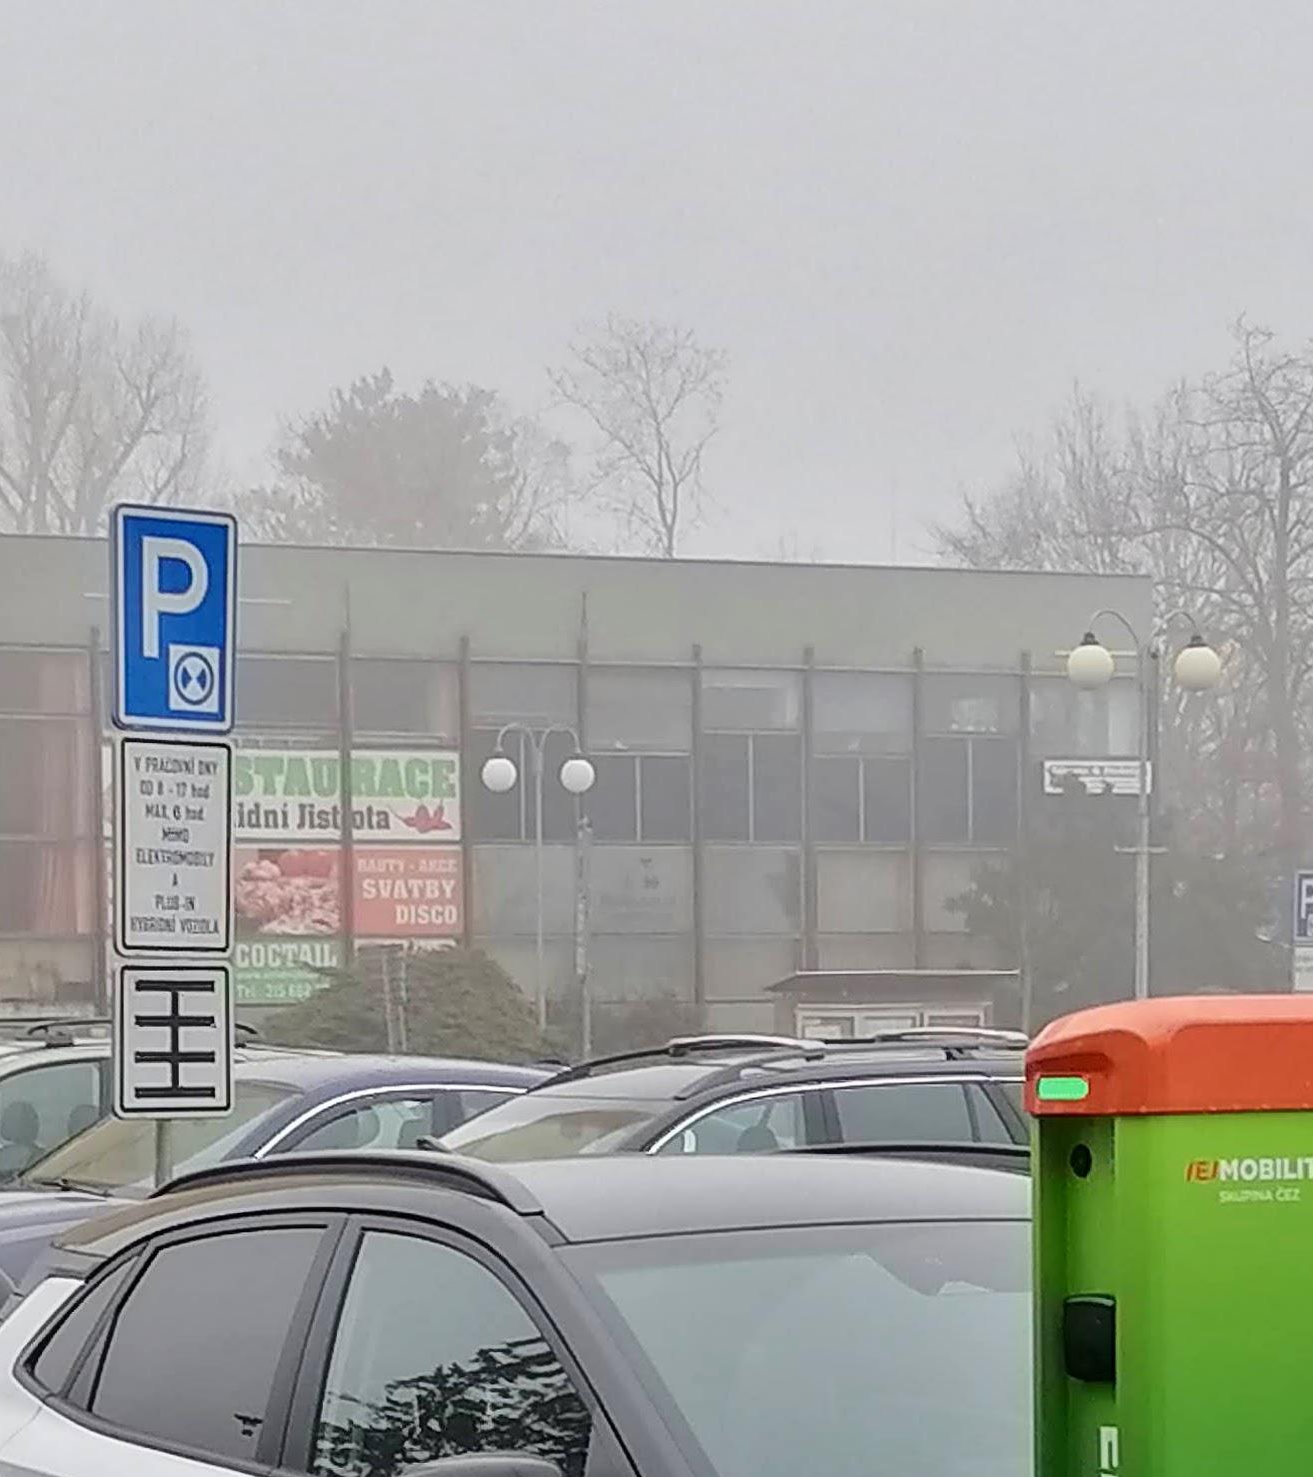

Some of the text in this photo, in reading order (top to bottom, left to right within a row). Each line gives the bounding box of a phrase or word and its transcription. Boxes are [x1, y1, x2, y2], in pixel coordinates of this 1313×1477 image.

[142, 535, 210, 659] P
[134, 756, 218, 775] V PRACOVNÍ DNY
[140, 780, 154, 796] OD
[296, 803, 391, 830] Jistota
[362, 878, 456, 900] SVATBY
[394, 904, 458, 925] DISCO
[236, 943, 337, 968] COCTAIL
[1275, 1186, 1301, 1202] ČEZ
